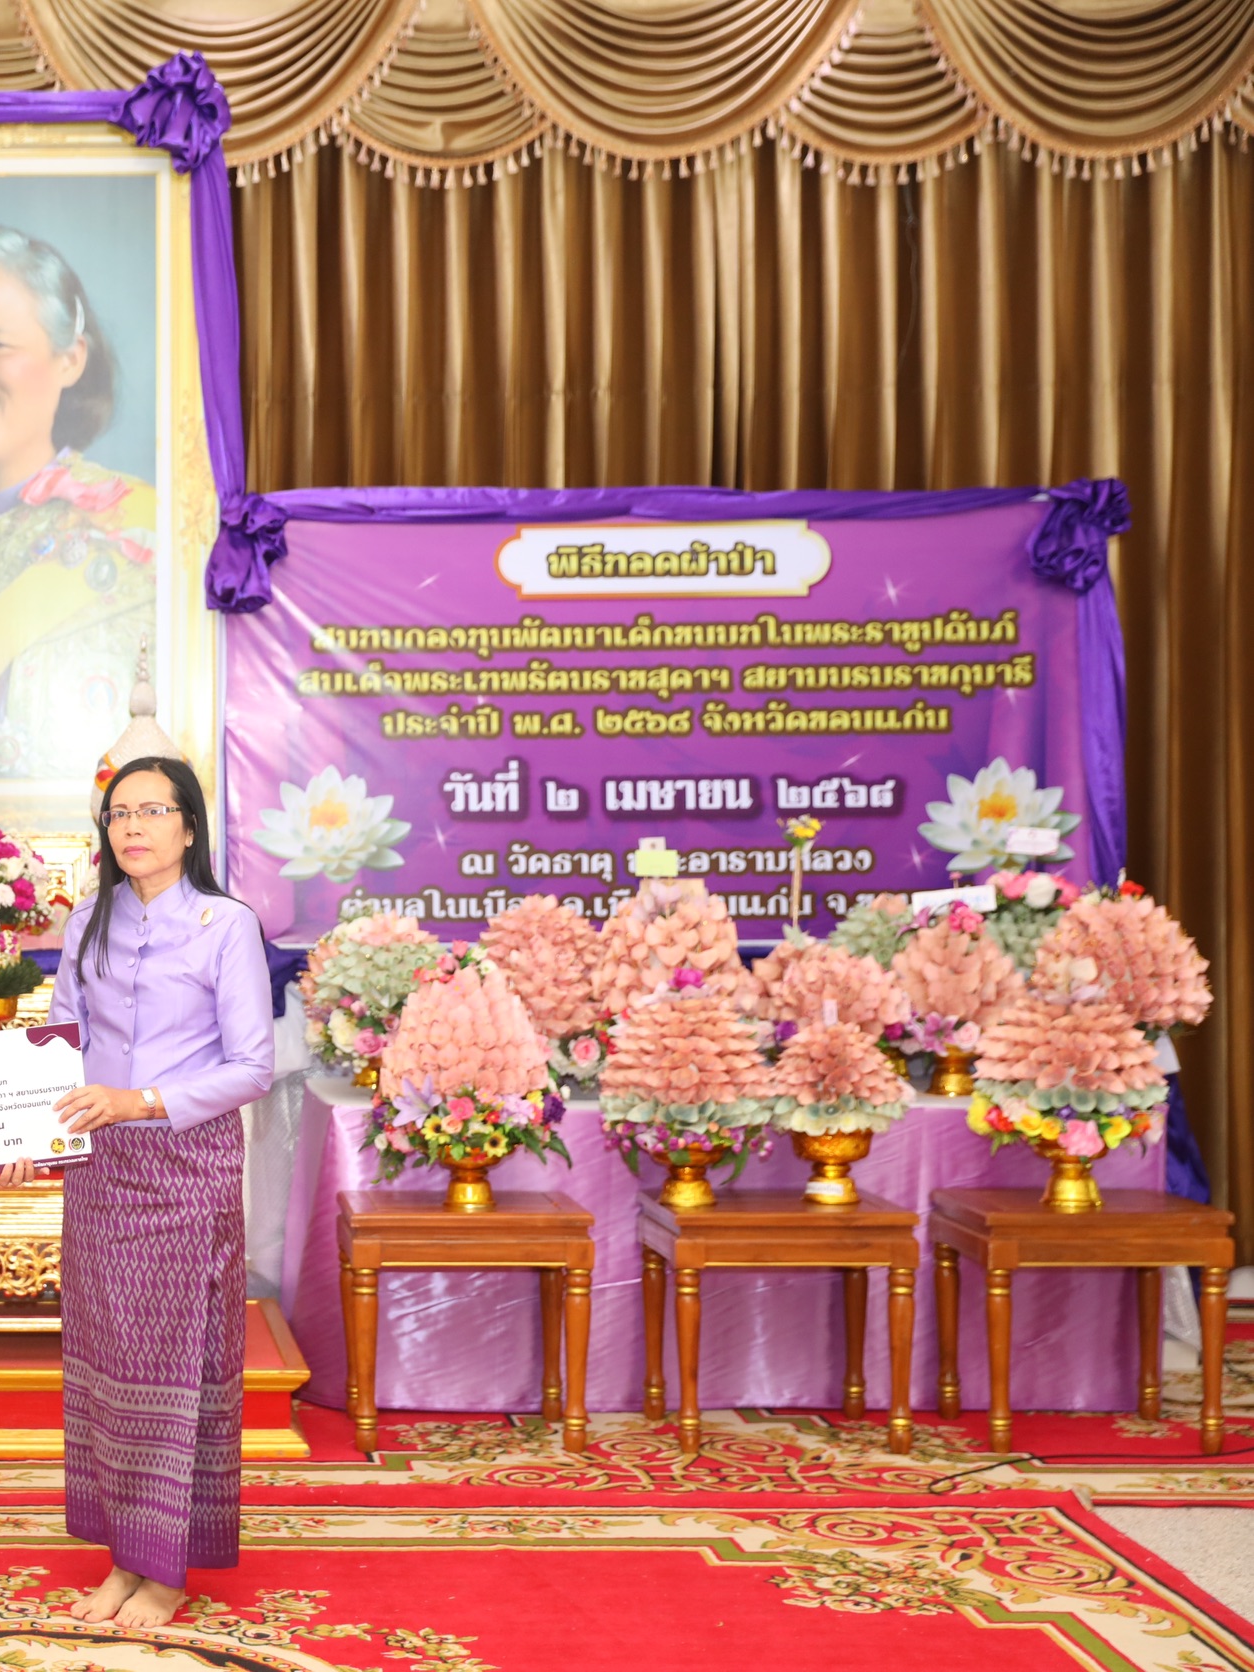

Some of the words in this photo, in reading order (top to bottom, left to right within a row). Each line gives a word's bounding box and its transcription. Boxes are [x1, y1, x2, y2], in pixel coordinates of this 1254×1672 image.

[547, 541, 776, 578] พิธีทอดผ้าป่า
[312, 611, 1017, 658] สมทบกองทุนพัฒนาเด็กชนบทในพระราชูปถัมภ์
[298, 659, 730, 698] สมเด็จพระเทพรัตนราชสุดาฯ
[742, 655, 1034, 694] สยามบรมราชกุมารี
[382, 707, 499, 737] ประจำปี
[513, 709, 582, 736] พ.ศ.
[596, 709, 691, 735] ๒๕๖๘
[701, 702, 949, 734] จังหวัดขอนแก่น
[443, 760, 520, 812] วันที่
[545, 781, 579, 812] ๒
[605, 778, 752, 811] เมษายน
[776, 777, 896, 810] ๒๕๖๘
[461, 852, 494, 875] ณ
[508, 844, 613, 881] วัดธาตุ
[626, 849, 873, 874] ะอารามหลวง
[3, 1136, 23, 1148] บาท
